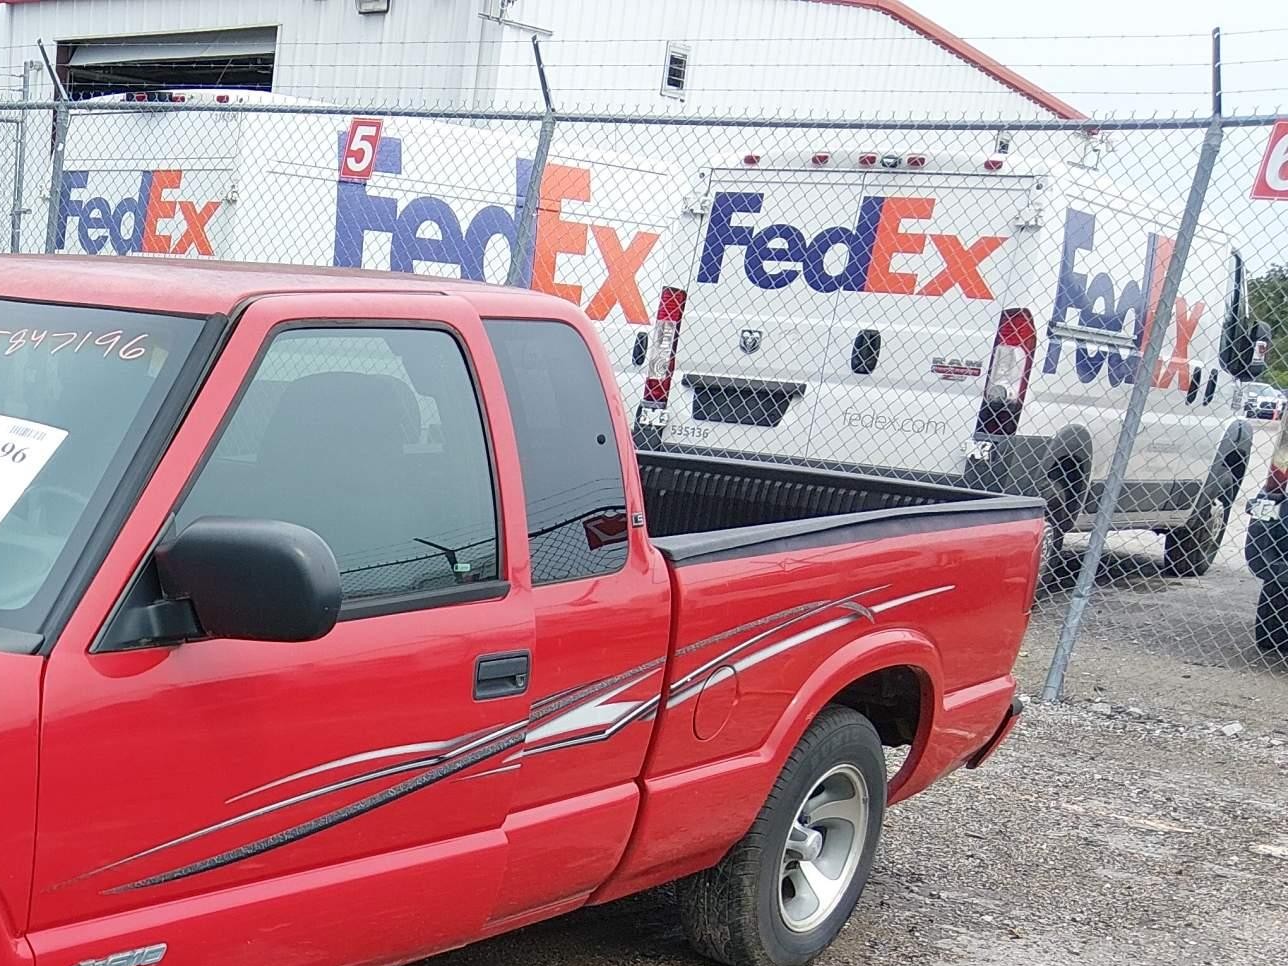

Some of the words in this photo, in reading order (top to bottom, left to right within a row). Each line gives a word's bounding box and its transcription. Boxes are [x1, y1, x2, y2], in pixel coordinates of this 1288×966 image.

[345, 125, 377, 173] 5
[55, 169, 222, 257] FedEx
[334, 130, 661, 326] FedEx
[696, 192, 1010, 301] FedEx
[670, 425, 710, 439] 535136
[842, 406, 947, 437] fedex.com
